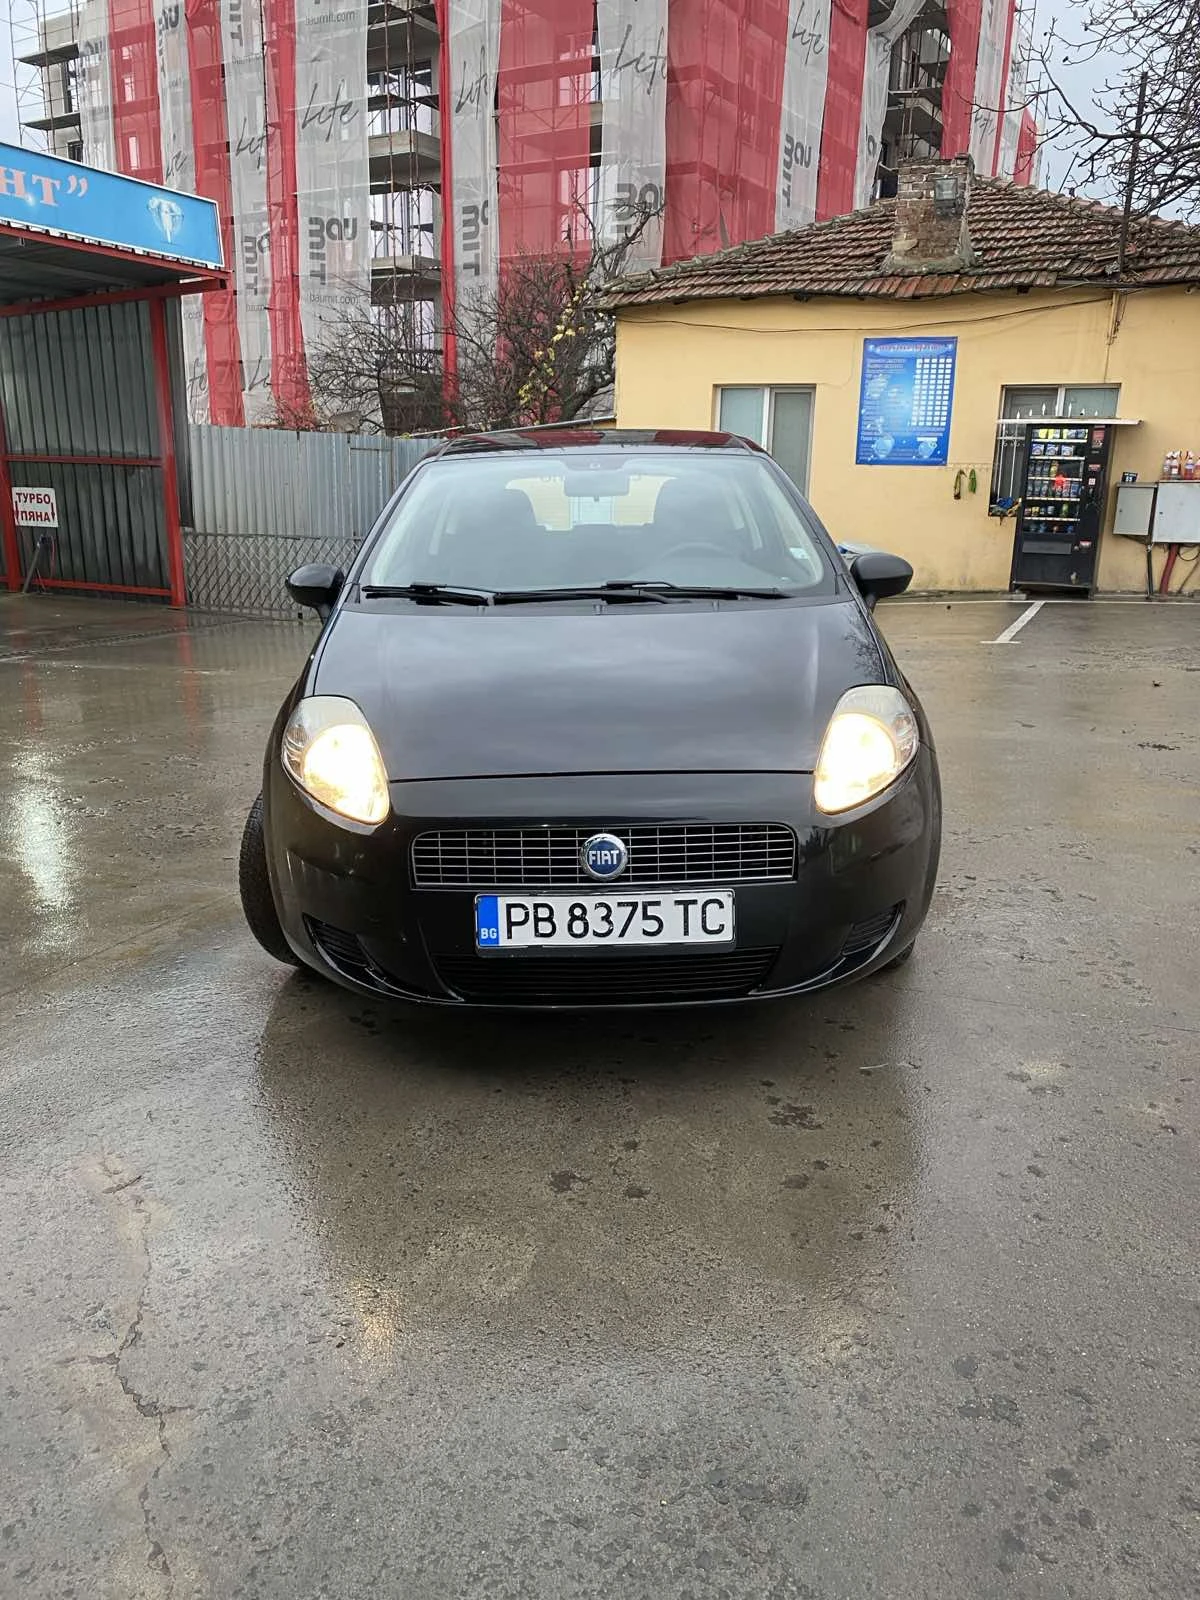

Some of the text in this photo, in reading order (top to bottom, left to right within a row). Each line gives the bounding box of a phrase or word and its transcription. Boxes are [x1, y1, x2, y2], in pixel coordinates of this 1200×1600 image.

[15, 492, 51, 504] ТУРБО
[21, 510, 51, 522] ПЯНА
[588, 850, 619, 865] FIAT
[505, 898, 725, 940] PB 8375 TC
[480, 928, 498, 939] BG
